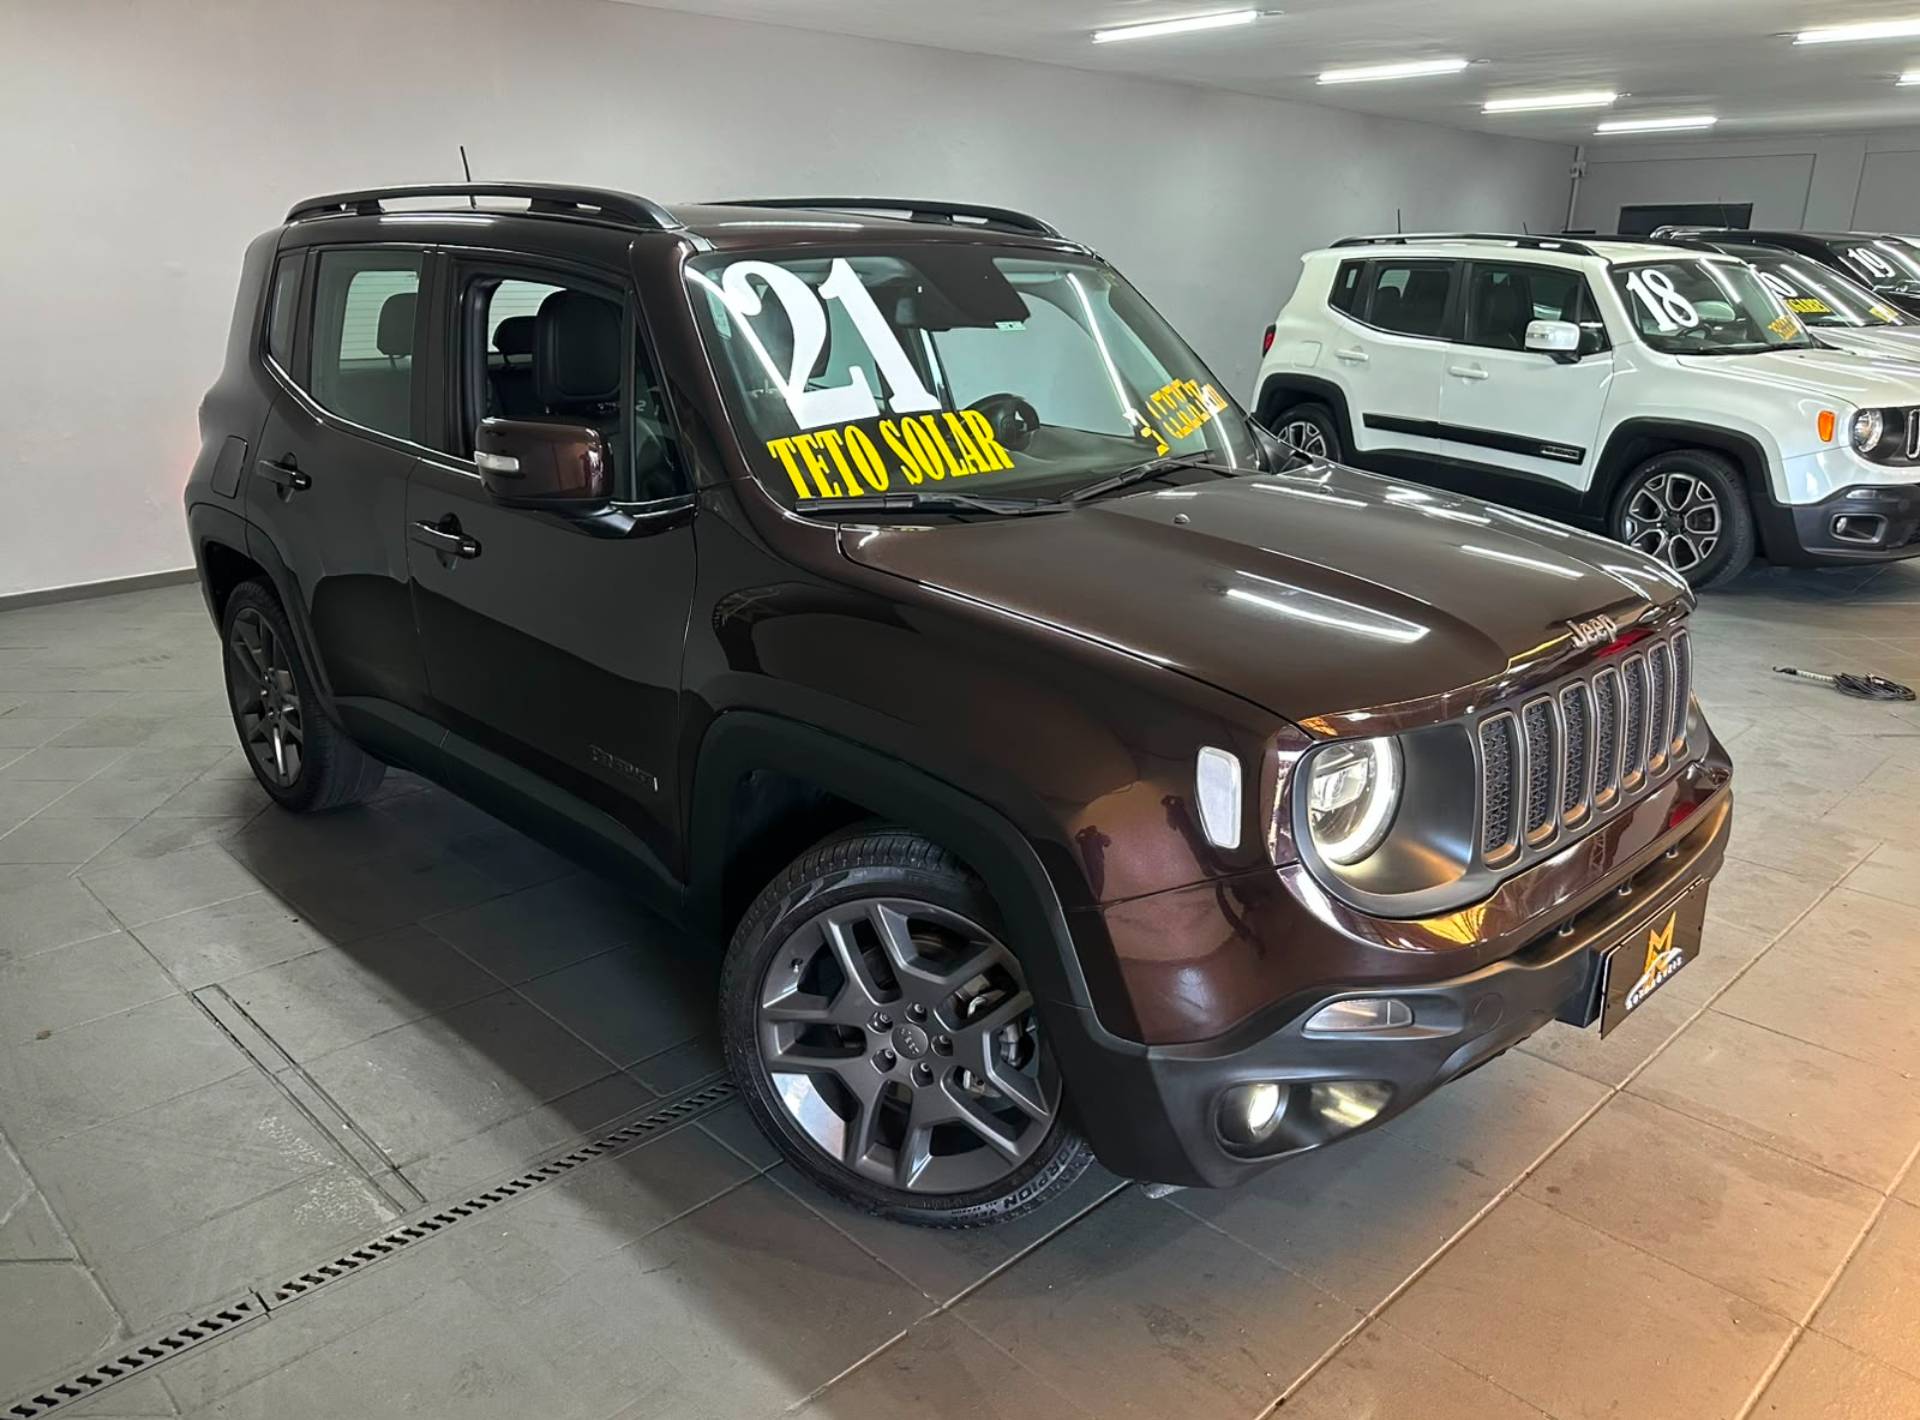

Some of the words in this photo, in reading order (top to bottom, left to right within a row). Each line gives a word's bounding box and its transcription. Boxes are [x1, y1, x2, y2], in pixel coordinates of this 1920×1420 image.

[1847, 248, 1896, 277] 19
[1626, 269, 1699, 332] 18
[721, 258, 942, 430] 21
[767, 424, 889, 500] TETO
[879, 409, 1015, 486] SOLAR
[1566, 614, 1616, 648] Jeep
